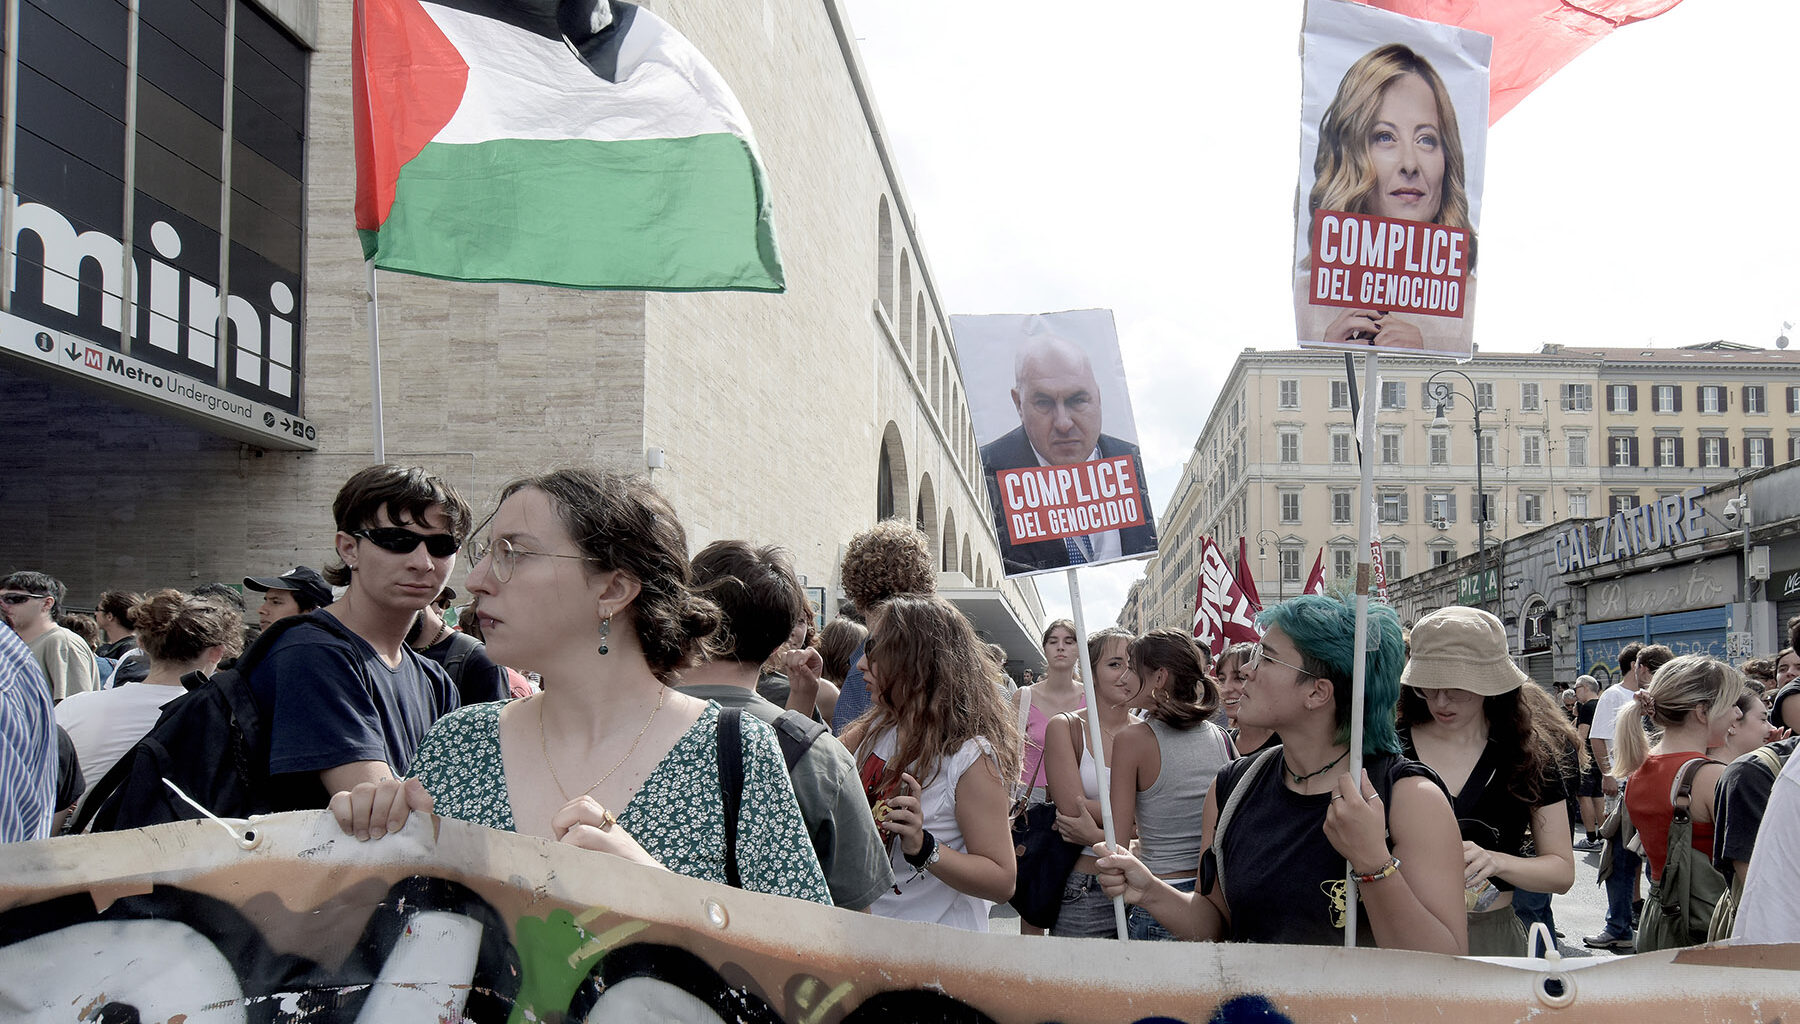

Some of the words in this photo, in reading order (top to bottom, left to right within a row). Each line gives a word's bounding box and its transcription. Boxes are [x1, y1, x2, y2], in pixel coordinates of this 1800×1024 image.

[1319, 215, 1464, 277] COMPLICE
[1316, 266, 1353, 302] DEL
[1359, 271, 1460, 312] GENOCIDIO
[106, 355, 163, 388] Metro
[166, 375, 252, 418] Underground
[1004, 459, 1134, 511] COMPLICE
[1011, 511, 1047, 540] DEL
[1048, 497, 1138, 535] GENOCIDIO
[1554, 486, 1709, 574] CALZATURE
